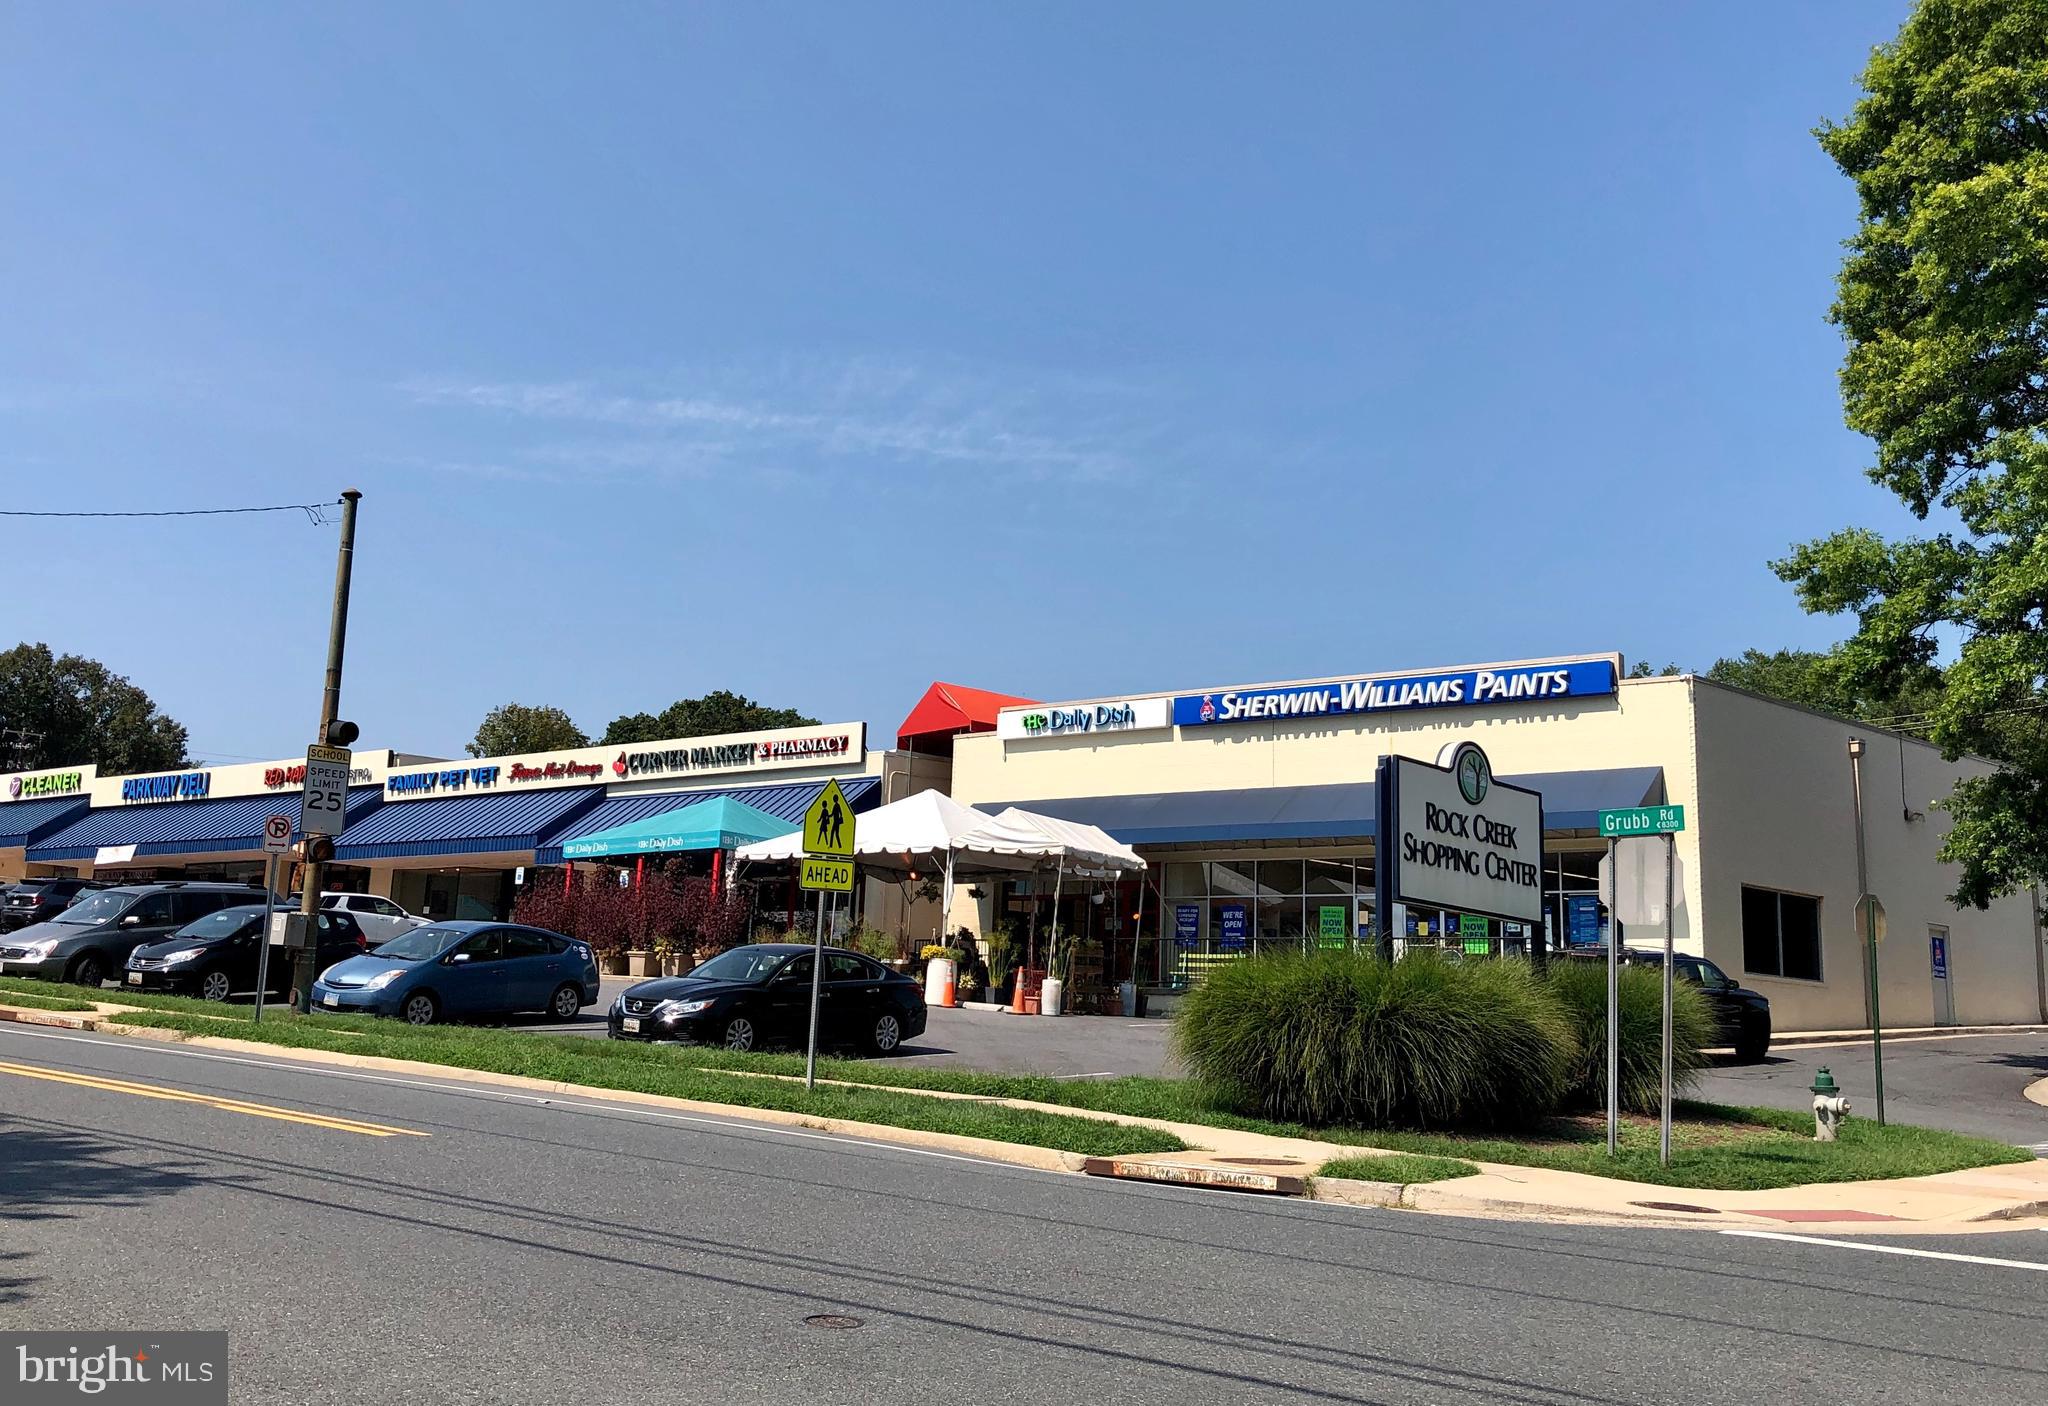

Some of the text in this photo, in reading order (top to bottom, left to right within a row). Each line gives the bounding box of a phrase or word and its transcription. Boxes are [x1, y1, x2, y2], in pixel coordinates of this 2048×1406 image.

[1219, 669, 1570, 720] SHERWIN-WILLIAMS PAINTS
[1048, 708, 1092, 731] Daily
[1094, 703, 1136, 726] Dish
[310, 748, 348, 760] SCHOOL
[628, 736, 846, 769] CORNER MARKET & PHARMACY
[310, 767, 346, 779] SPEED
[348, 767, 369, 779] STRO
[387, 771, 436, 791] FAMILY
[440, 768, 467, 787] PET
[470, 766, 499, 783] VET
[22, 772, 81, 793] CLEANER
[122, 772, 210, 800] PARKWAY DELI
[312, 779, 341, 789] LIMIT
[306, 790, 342, 811] 25
[1425, 801, 1518, 850] ROCK CREEK
[1605, 808, 1674, 831] Grubb Rd
[1661, 820, 1679, 828] 8300
[576, 843, 592, 855] Daily
[592, 842, 609, 852] Dish
[649, 838, 666, 850] Daily
[667, 836, 684, 847] Dish
[1403, 831, 1538, 888] SHOPPING CENTER
[805, 866, 849, 884] AHEAD
[1222, 911, 1244, 919] WE'RE
[1224, 920, 1242, 929] OPEN
[1322, 919, 1342, 927] NOW
[1463, 923, 1485, 931] NOW
[1321, 926, 1343, 935] OPEN
